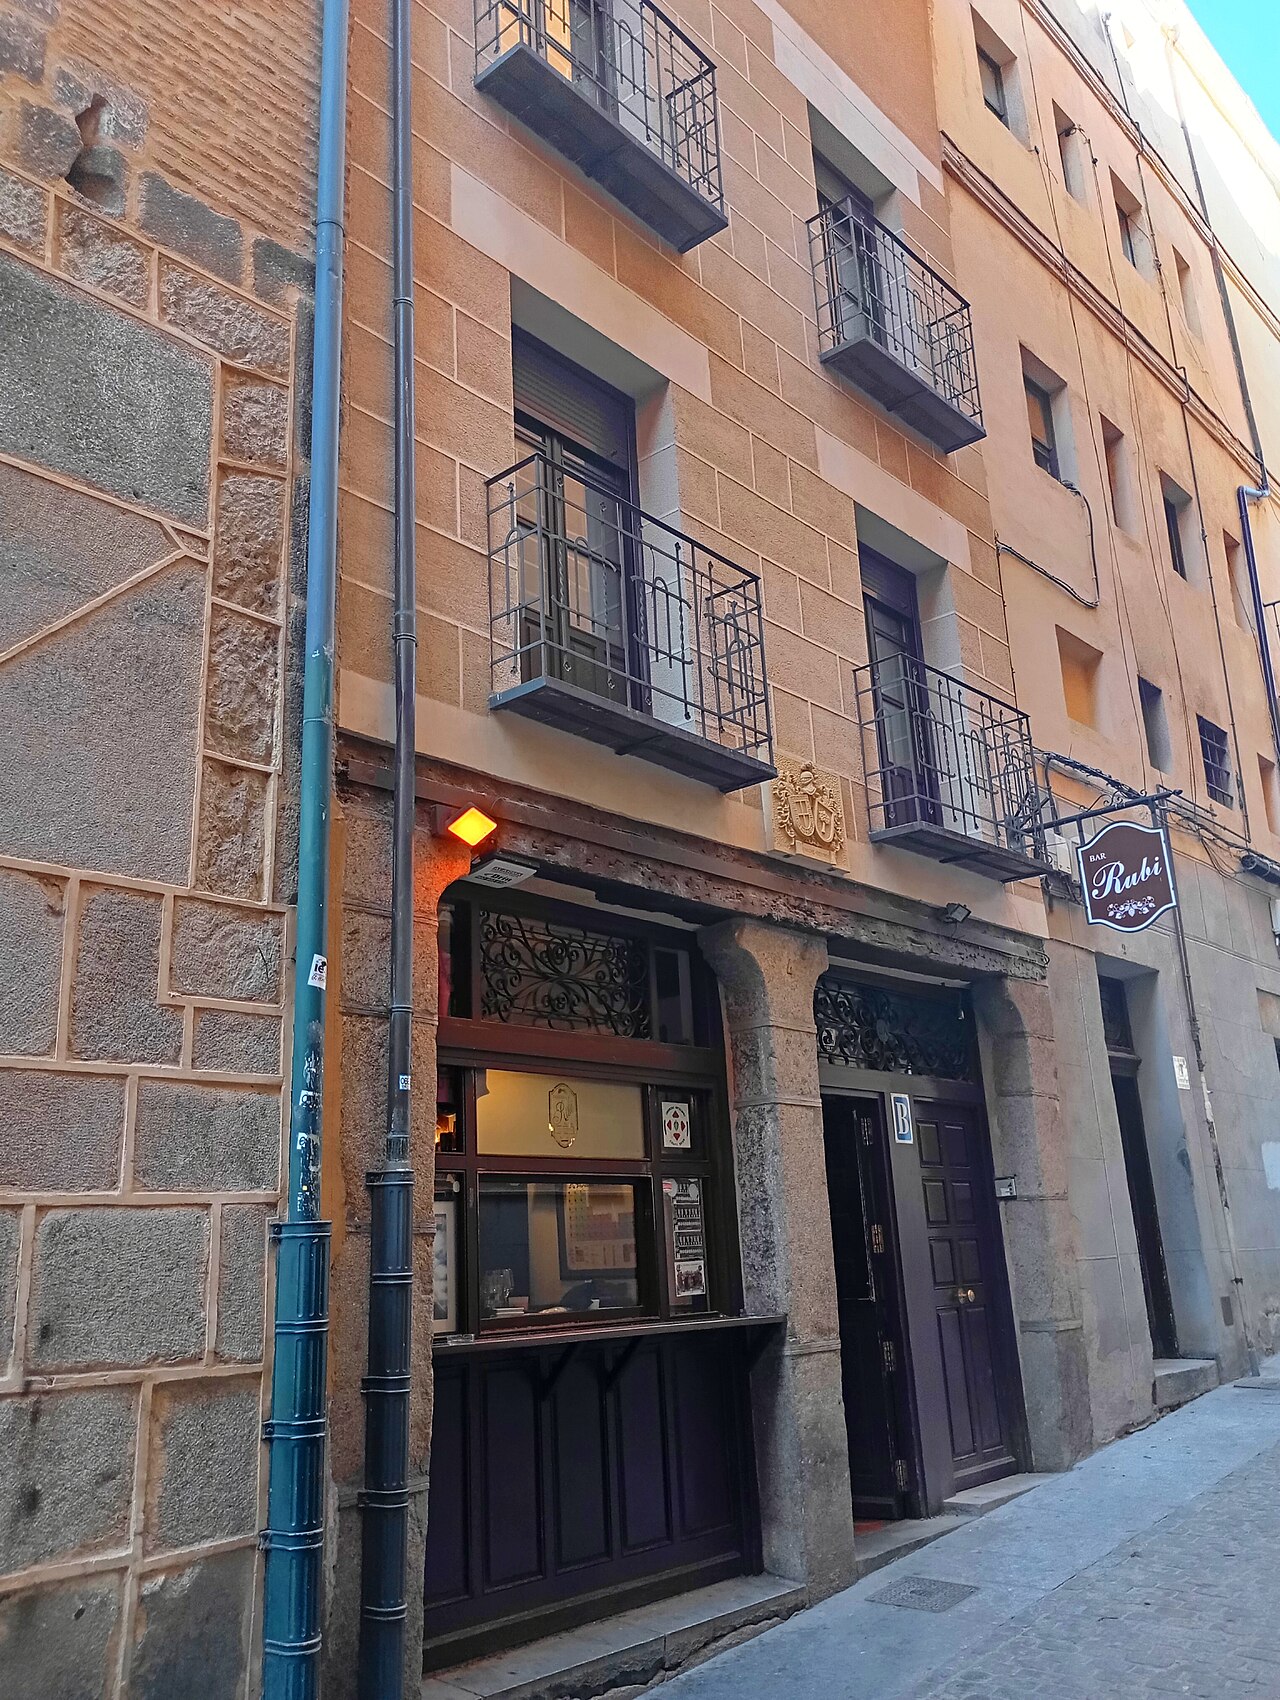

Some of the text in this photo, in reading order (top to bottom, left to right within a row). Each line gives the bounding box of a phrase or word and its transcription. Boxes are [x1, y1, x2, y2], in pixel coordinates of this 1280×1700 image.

[1089, 852, 1107, 863] BAR
[1092, 857, 1162, 899] Rubi
[895, 1102, 909, 1134] B
